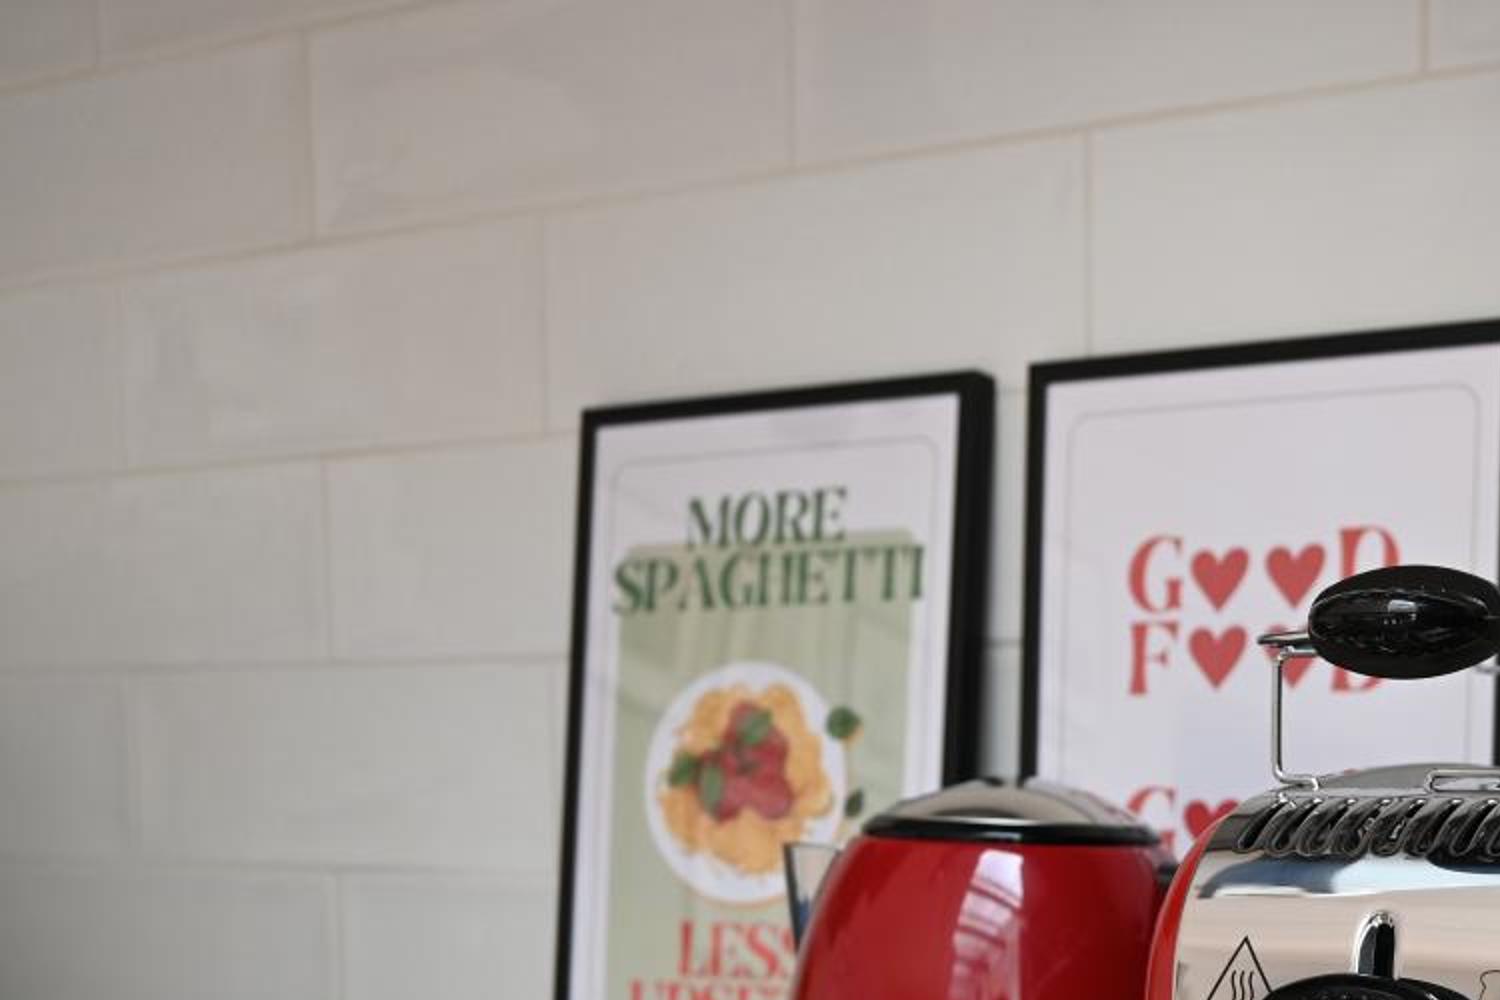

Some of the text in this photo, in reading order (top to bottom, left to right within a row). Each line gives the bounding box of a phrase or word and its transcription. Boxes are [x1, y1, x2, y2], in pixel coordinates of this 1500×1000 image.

[688, 486, 848, 550] MORE
[611, 545, 925, 615] SPAGHETTI
[677, 917, 796, 977] LES
